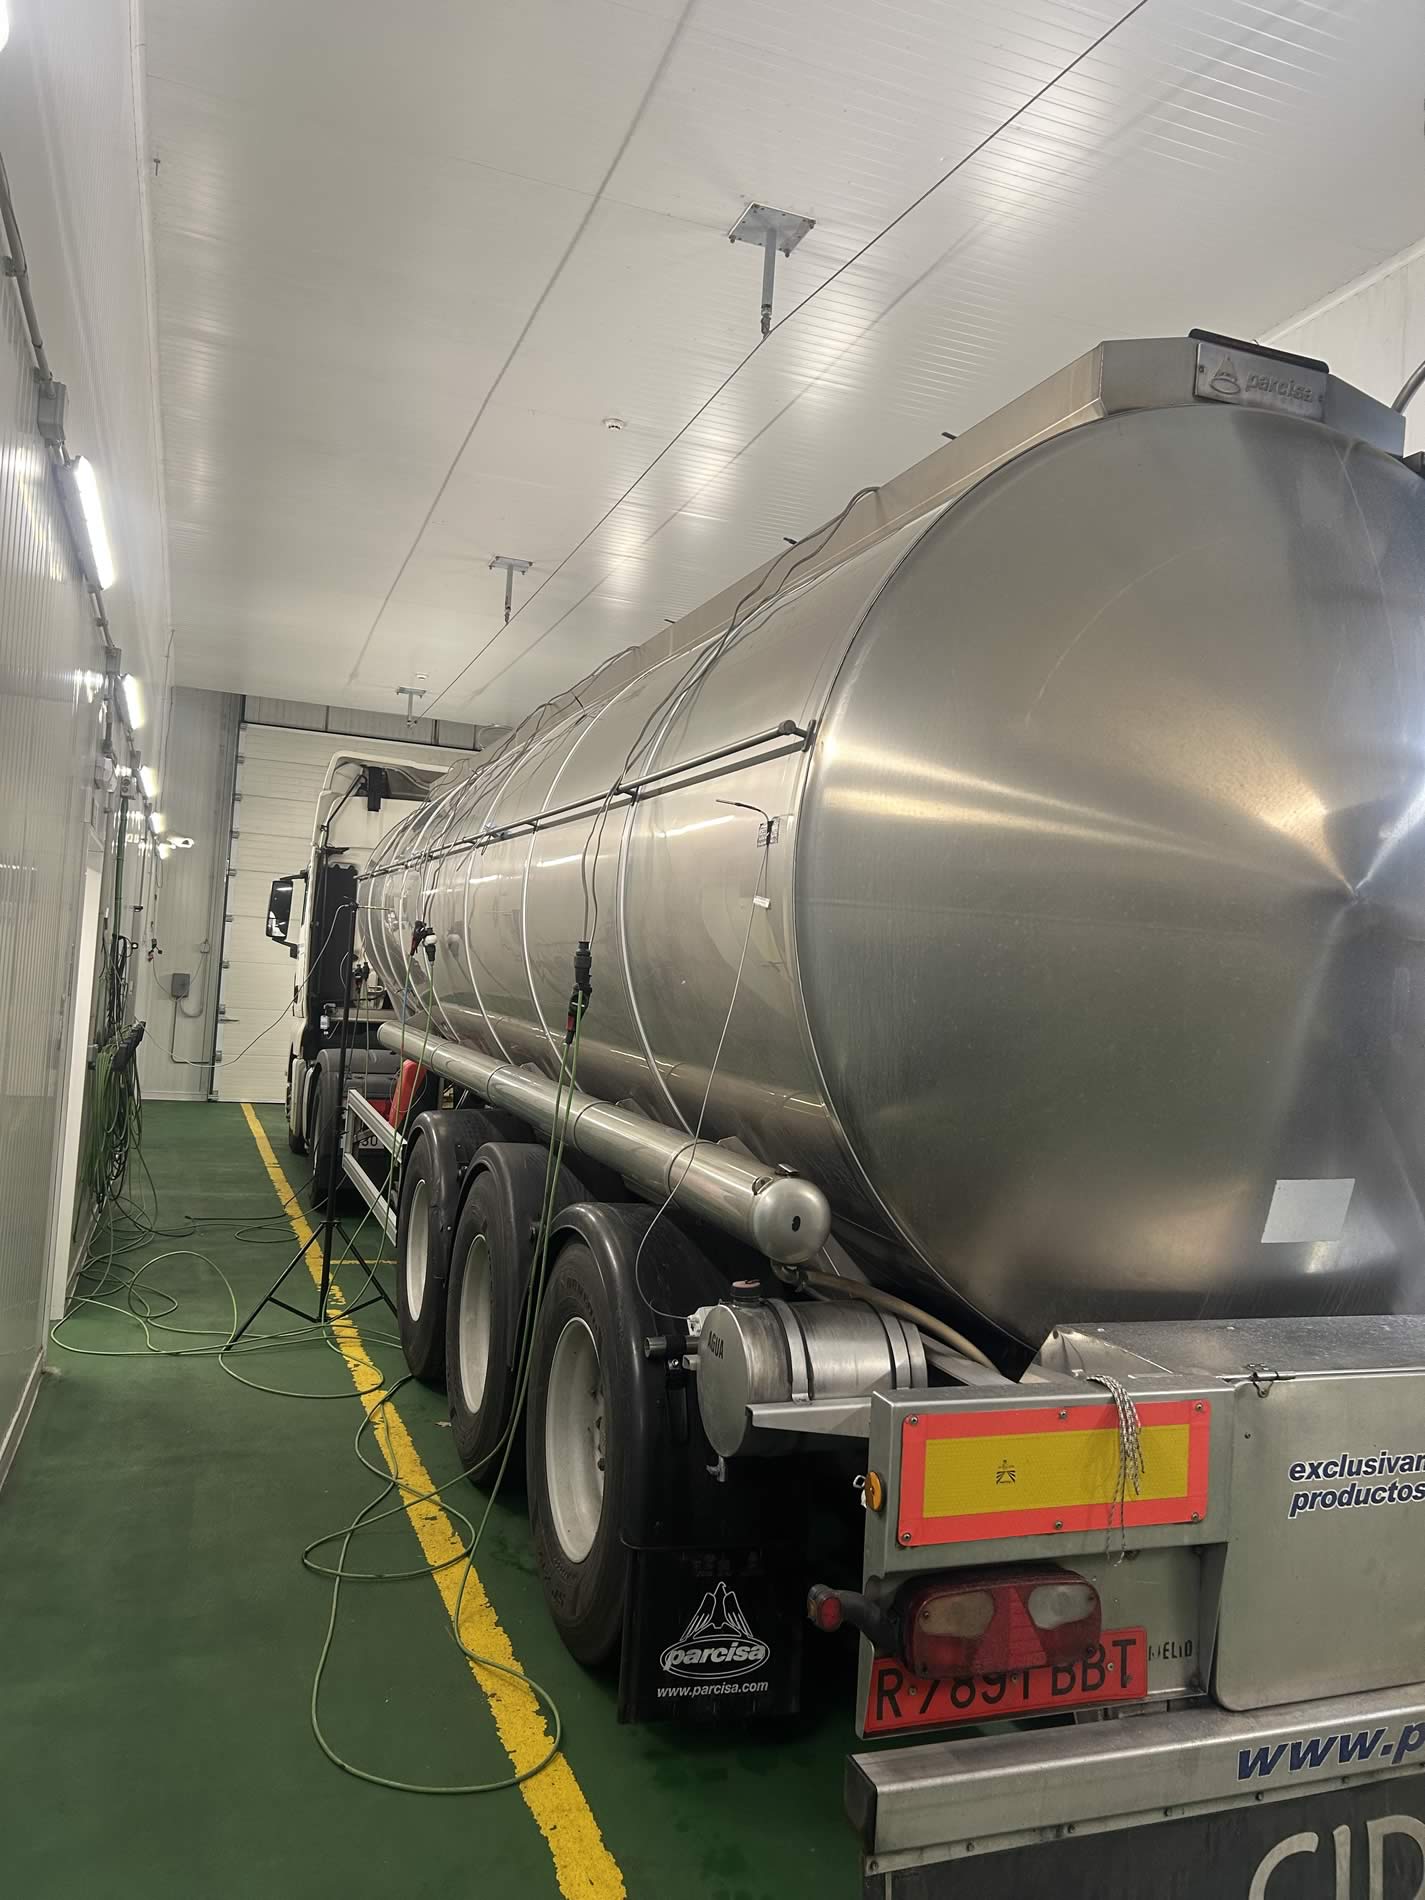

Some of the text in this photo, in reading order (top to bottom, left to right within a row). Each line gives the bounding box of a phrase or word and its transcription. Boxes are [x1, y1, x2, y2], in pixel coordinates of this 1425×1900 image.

[1245, 373, 1312, 402] parcisa
[708, 1331, 724, 1359] AGUA
[1288, 1478, 1425, 1519] productos
[663, 1642, 766, 1671] parcisa
[657, 1681, 769, 1698] www.parcisa.com
[876, 1667, 904, 1721] R
[1237, 1721, 1425, 1780] www.p
